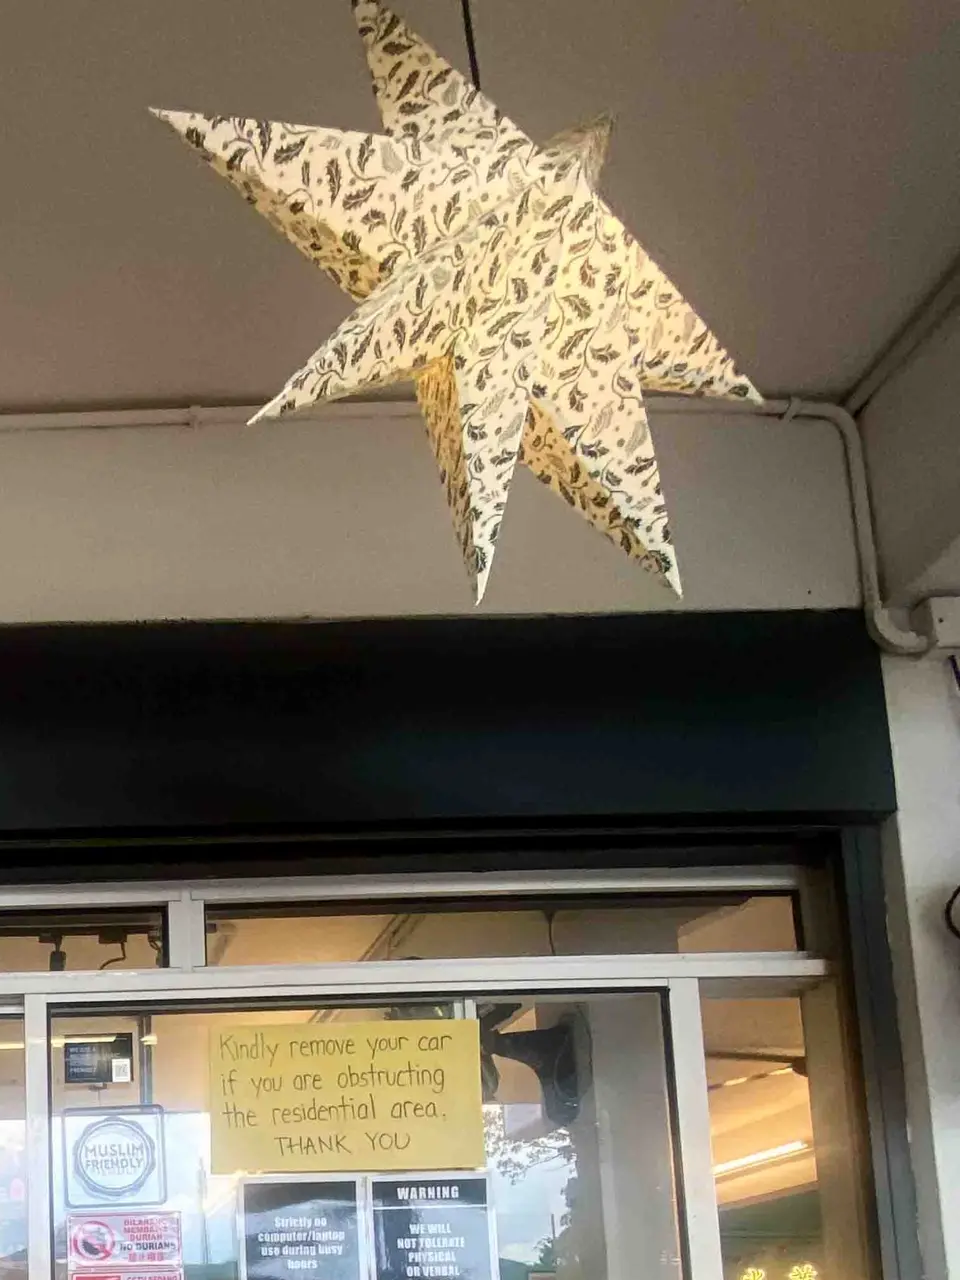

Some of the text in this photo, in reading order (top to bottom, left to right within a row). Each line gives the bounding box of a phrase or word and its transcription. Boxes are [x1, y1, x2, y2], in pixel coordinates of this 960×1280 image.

[219, 1032, 453, 1067] Kindly remove your car
[221, 1061, 445, 1097] if you are obstructing
[222, 1093, 446, 1128] the residential area.
[84, 1142, 144, 1158] MUSLIM
[274, 1131, 411, 1156] THANK YOU
[85, 1157, 144, 1170] FRIENDLY
[397, 1186, 459, 1200] WARNING
[275, 1216, 327, 1229] Strictly no
[410, 1223, 452, 1235] WE WILL
[258, 1230, 345, 1243] computer/laptop
[397, 1237, 465, 1249] NOT TOLERATE
[120, 1241, 177, 1251] NO DURIANS
[261, 1244, 343, 1256] use during busy
[408, 1251, 456, 1263] PHYSICAL
[288, 1259, 318, 1269] hours
[407, 1266, 460, 1277] OR VERBAL
